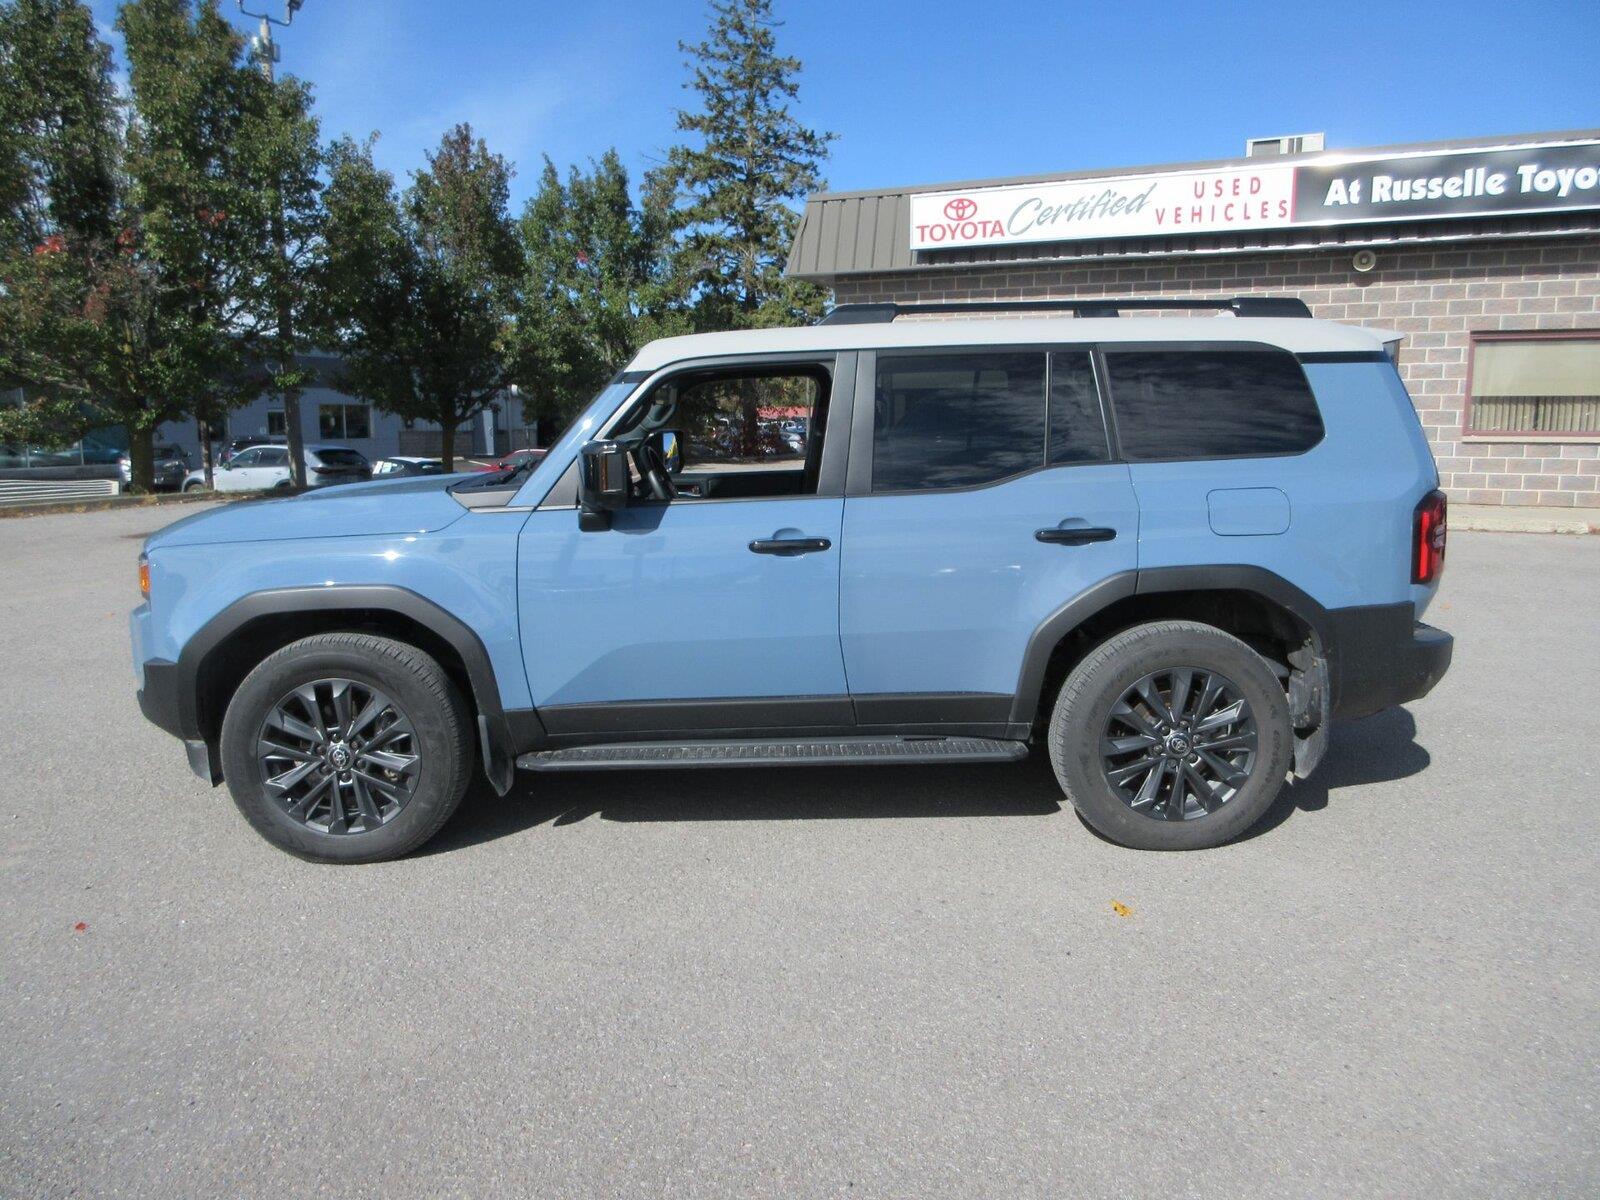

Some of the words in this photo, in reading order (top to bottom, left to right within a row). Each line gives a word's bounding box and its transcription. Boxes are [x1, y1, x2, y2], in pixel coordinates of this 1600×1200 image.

[1194, 176, 1262, 199] USED
[1323, 178, 1361, 206] At
[1370, 166, 1507, 203] Russelle
[1516, 164, 1600, 197] Toyo
[915, 219, 1005, 244] TOYOTA
[1007, 183, 1157, 235] Certified
[1155, 199, 1289, 226] VEHICLES
